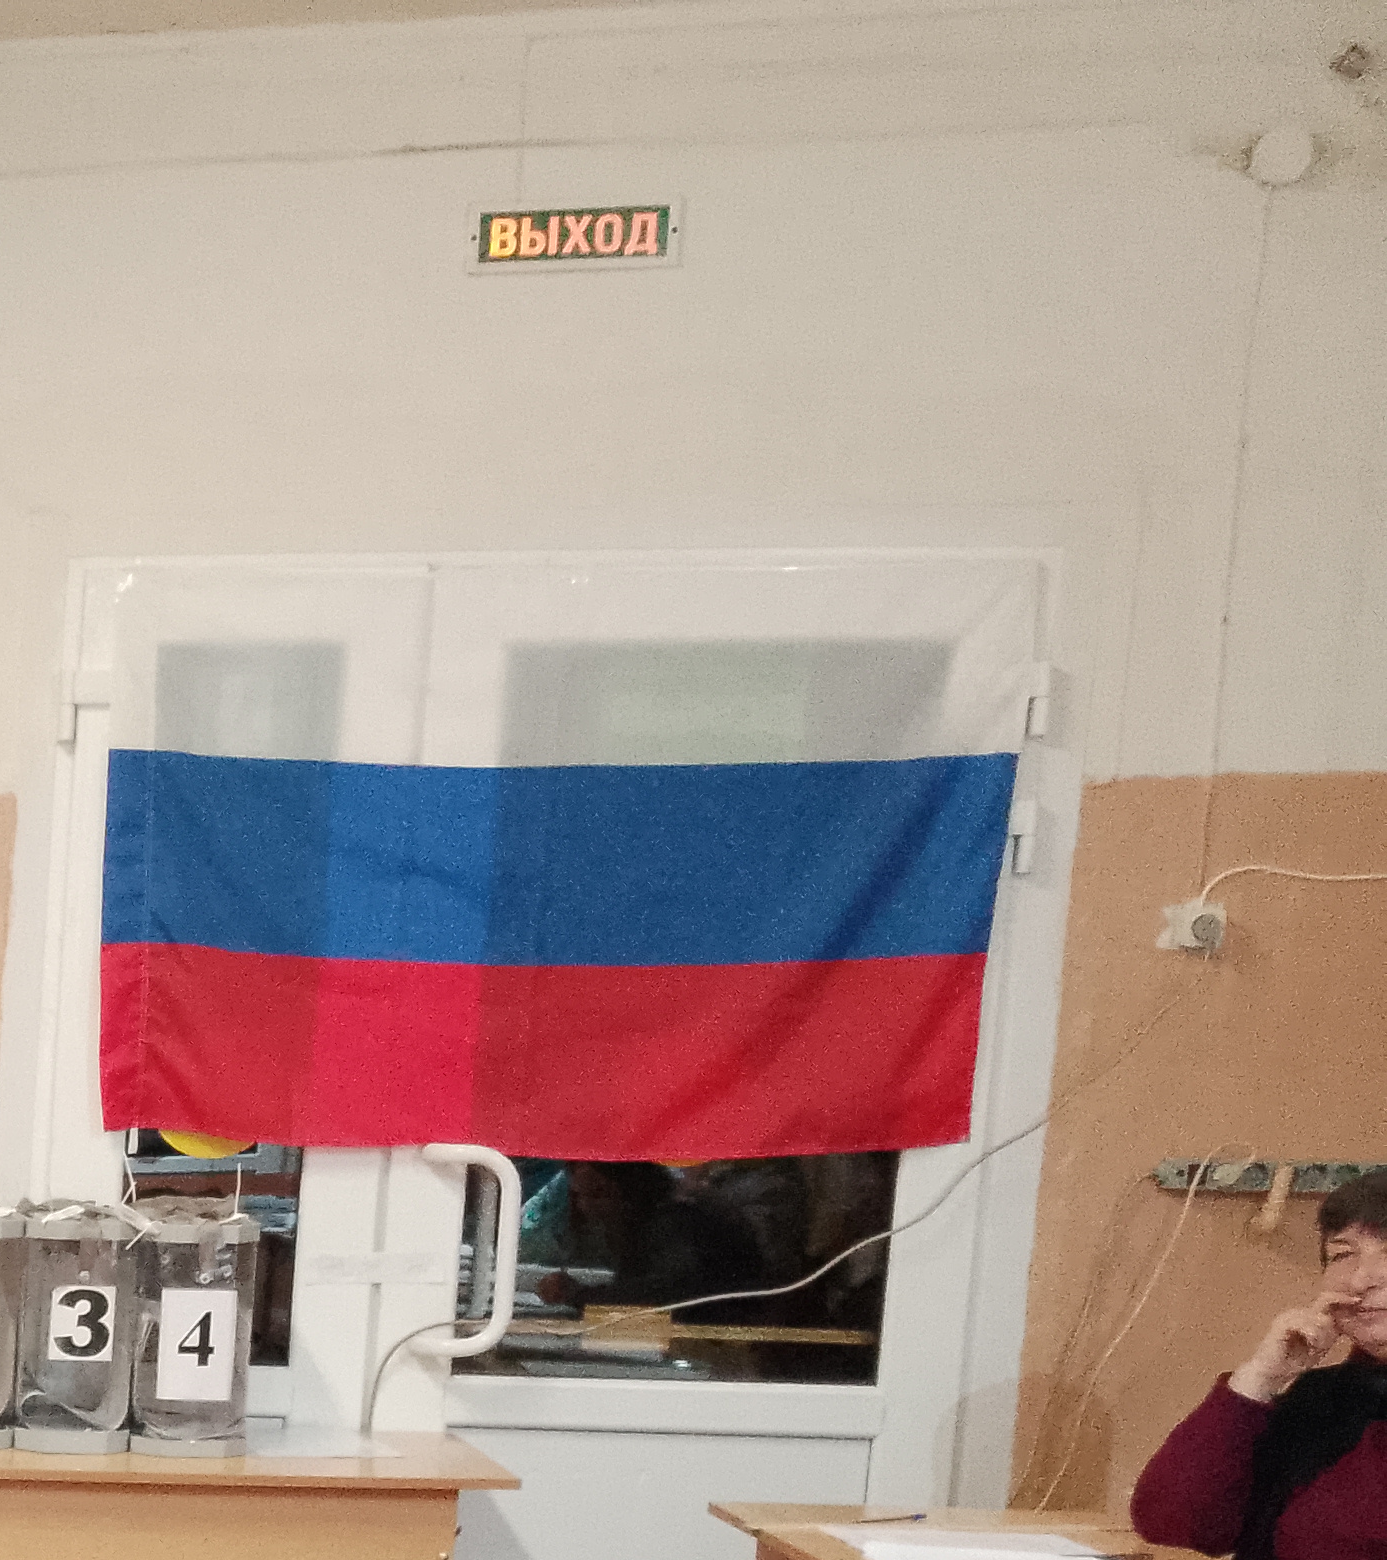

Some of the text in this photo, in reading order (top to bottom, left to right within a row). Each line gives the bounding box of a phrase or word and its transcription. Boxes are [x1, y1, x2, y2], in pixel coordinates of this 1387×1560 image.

[489, 212, 659, 257] ВЫХОД
[53, 1290, 111, 1357] 3
[177, 1310, 216, 1367] 4
